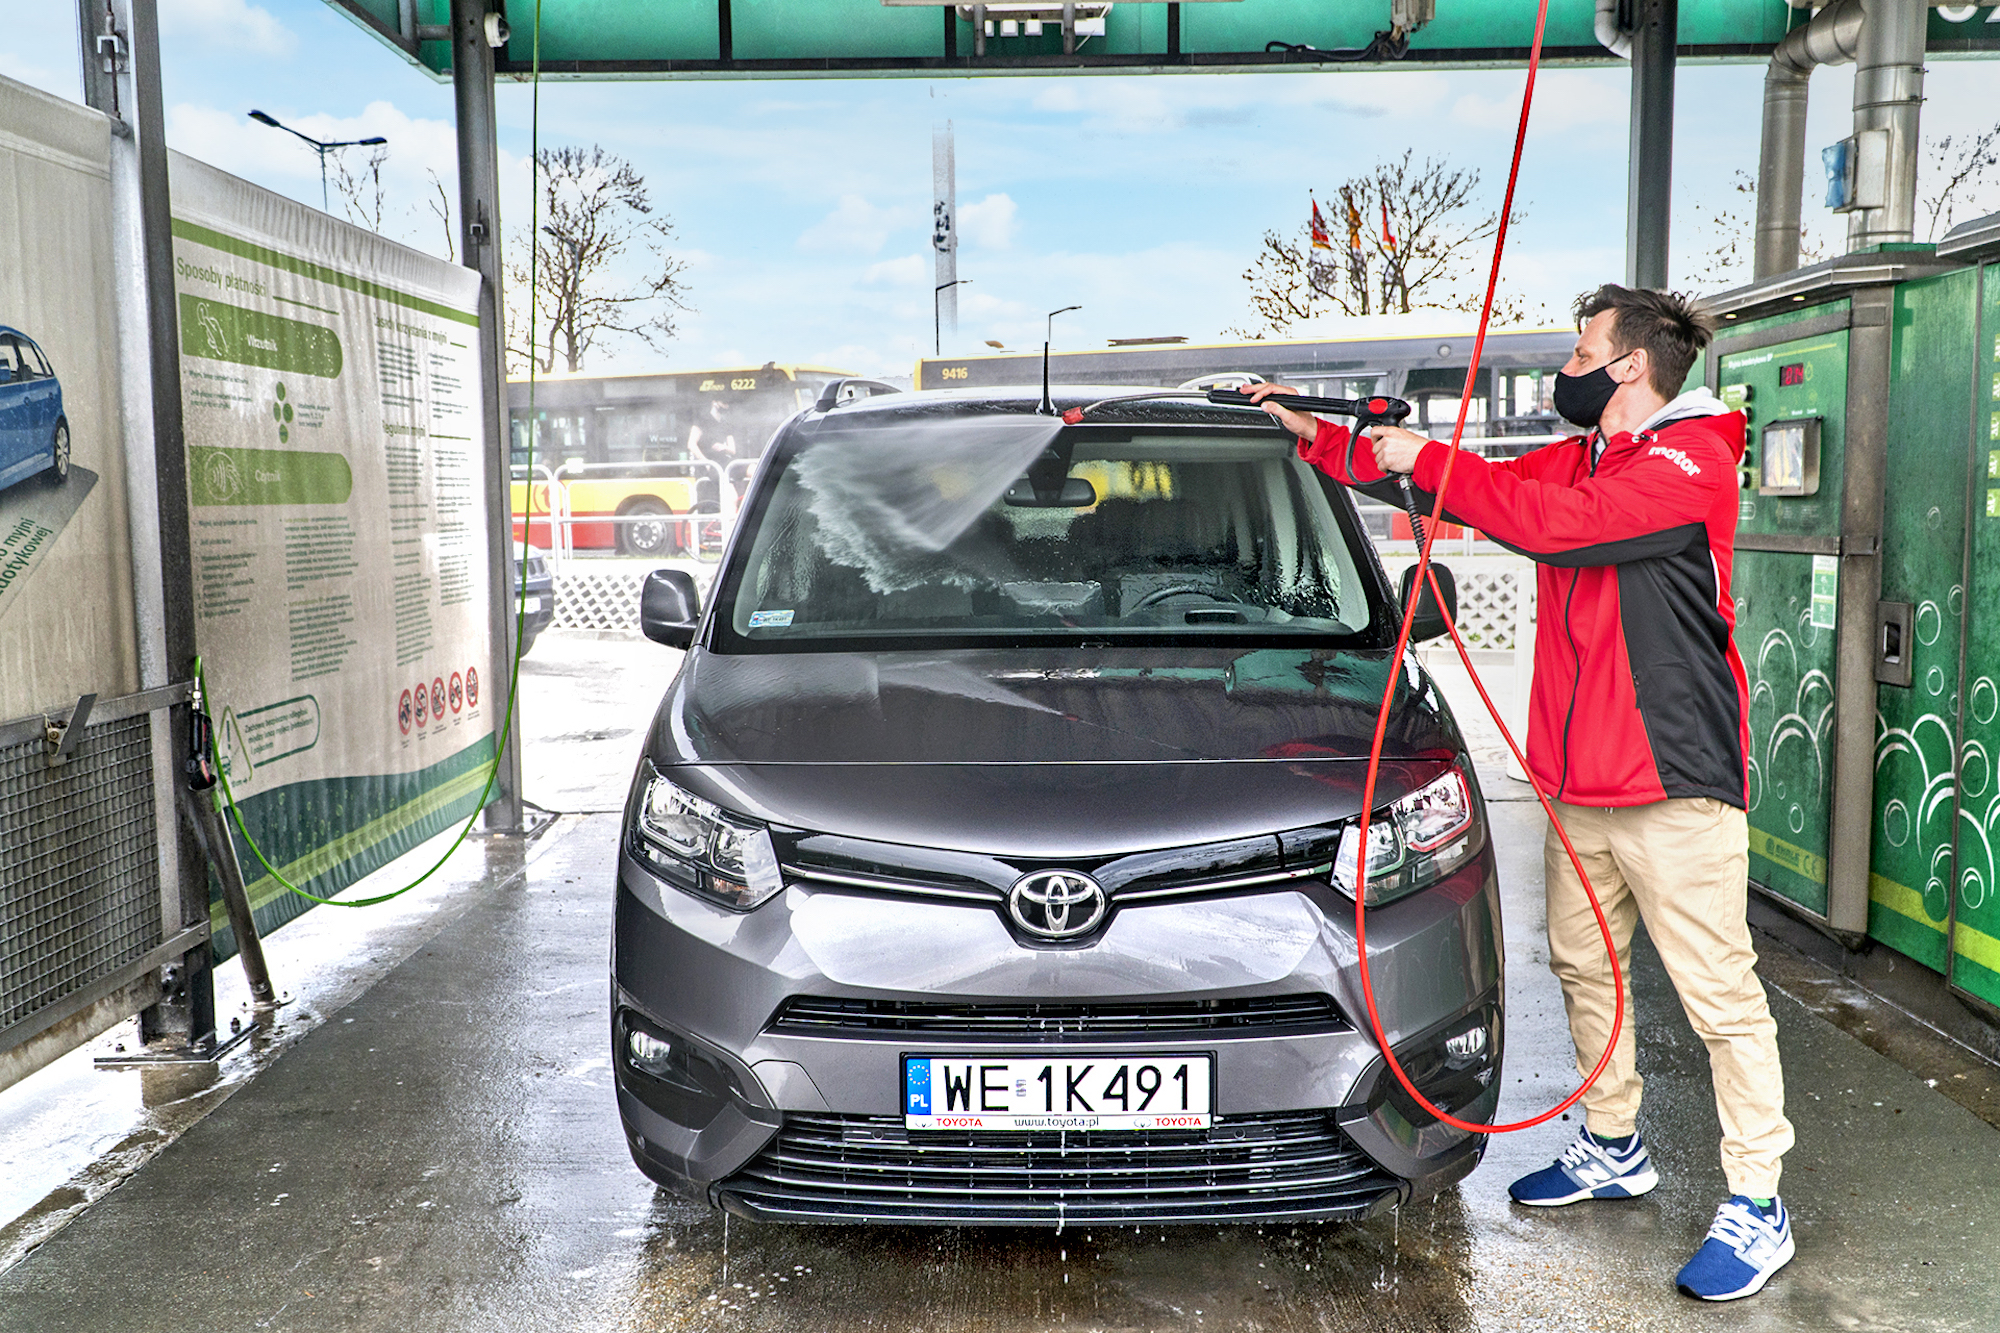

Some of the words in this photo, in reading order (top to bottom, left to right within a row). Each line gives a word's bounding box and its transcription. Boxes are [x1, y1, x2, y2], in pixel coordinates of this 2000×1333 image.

[177, 257, 223, 290] Sposoby
[225, 273, 268, 299] płatności
[942, 367, 968, 380] 9416
[730, 378, 756, 391] 6222
[1648, 446, 1701, 477] motor
[3, 517, 36, 547] myjni
[0, 526, 54, 596] dotykowej
[944, 1065, 1009, 1112] WE
[1037, 1064, 1189, 1112] 1K491
[910, 1093, 929, 1108] PL
[936, 1118, 983, 1127] TOYOTA
[1014, 1116, 1099, 1128] www.toyota.pl
[1155, 1117, 1202, 1126] TOYOTA
